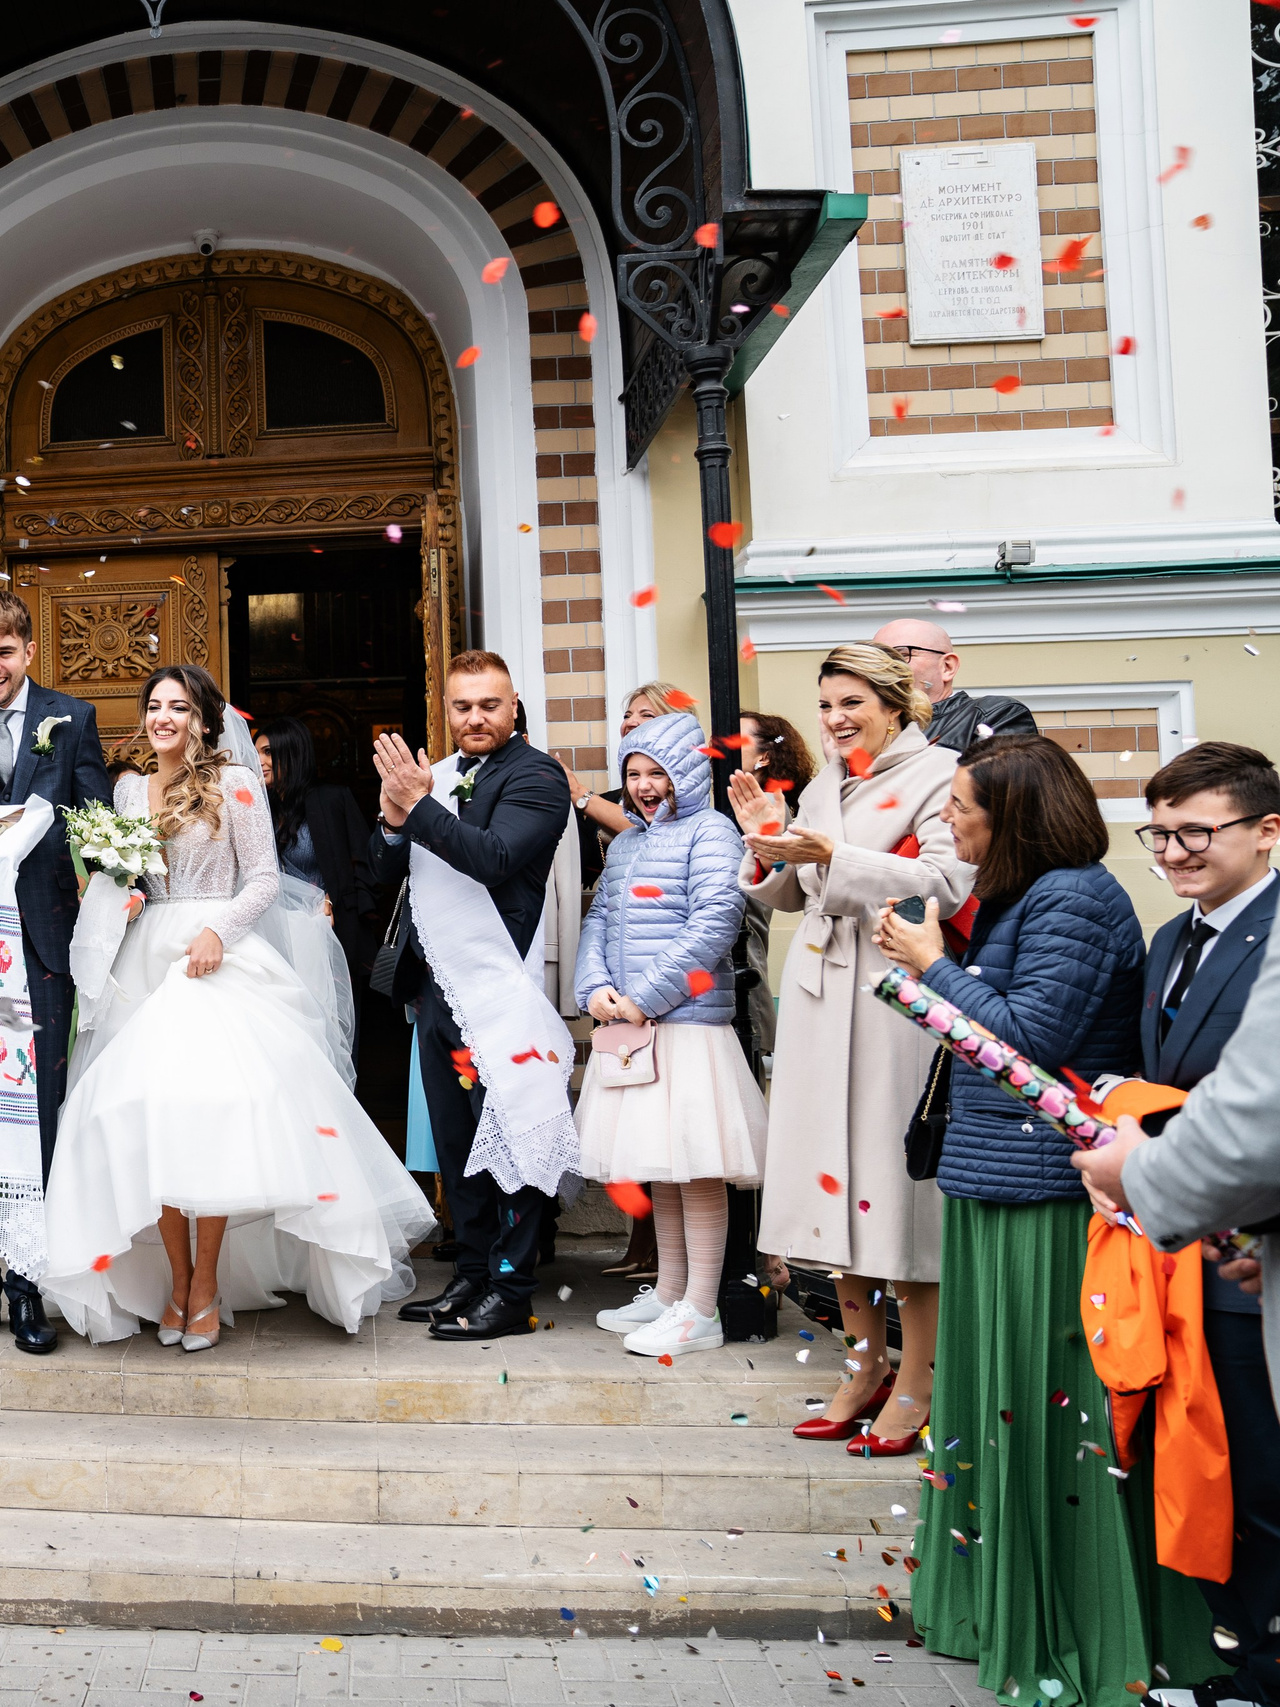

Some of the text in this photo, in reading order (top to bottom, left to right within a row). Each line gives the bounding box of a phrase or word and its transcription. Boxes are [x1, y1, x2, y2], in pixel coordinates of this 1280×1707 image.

[938, 182, 1001, 194] МОНУМЕНТ
[920, 193, 1022, 209] ДЕ АРХИТЕКТУРЭ
[930, 212, 967, 221] БИСЕРИКА
[962, 221, 984, 230] 1901
[987, 231, 1006, 240] СТАТ
[941, 257, 1003, 269] ПАМЯТНИ
[934, 268, 1020, 282] АРХИТЕКТУРЫ
[951, 296, 975, 306] 1901
[928, 306, 1026, 318] ОХРАНЯЕТСЯ ГОСУДАРСТВОМ
